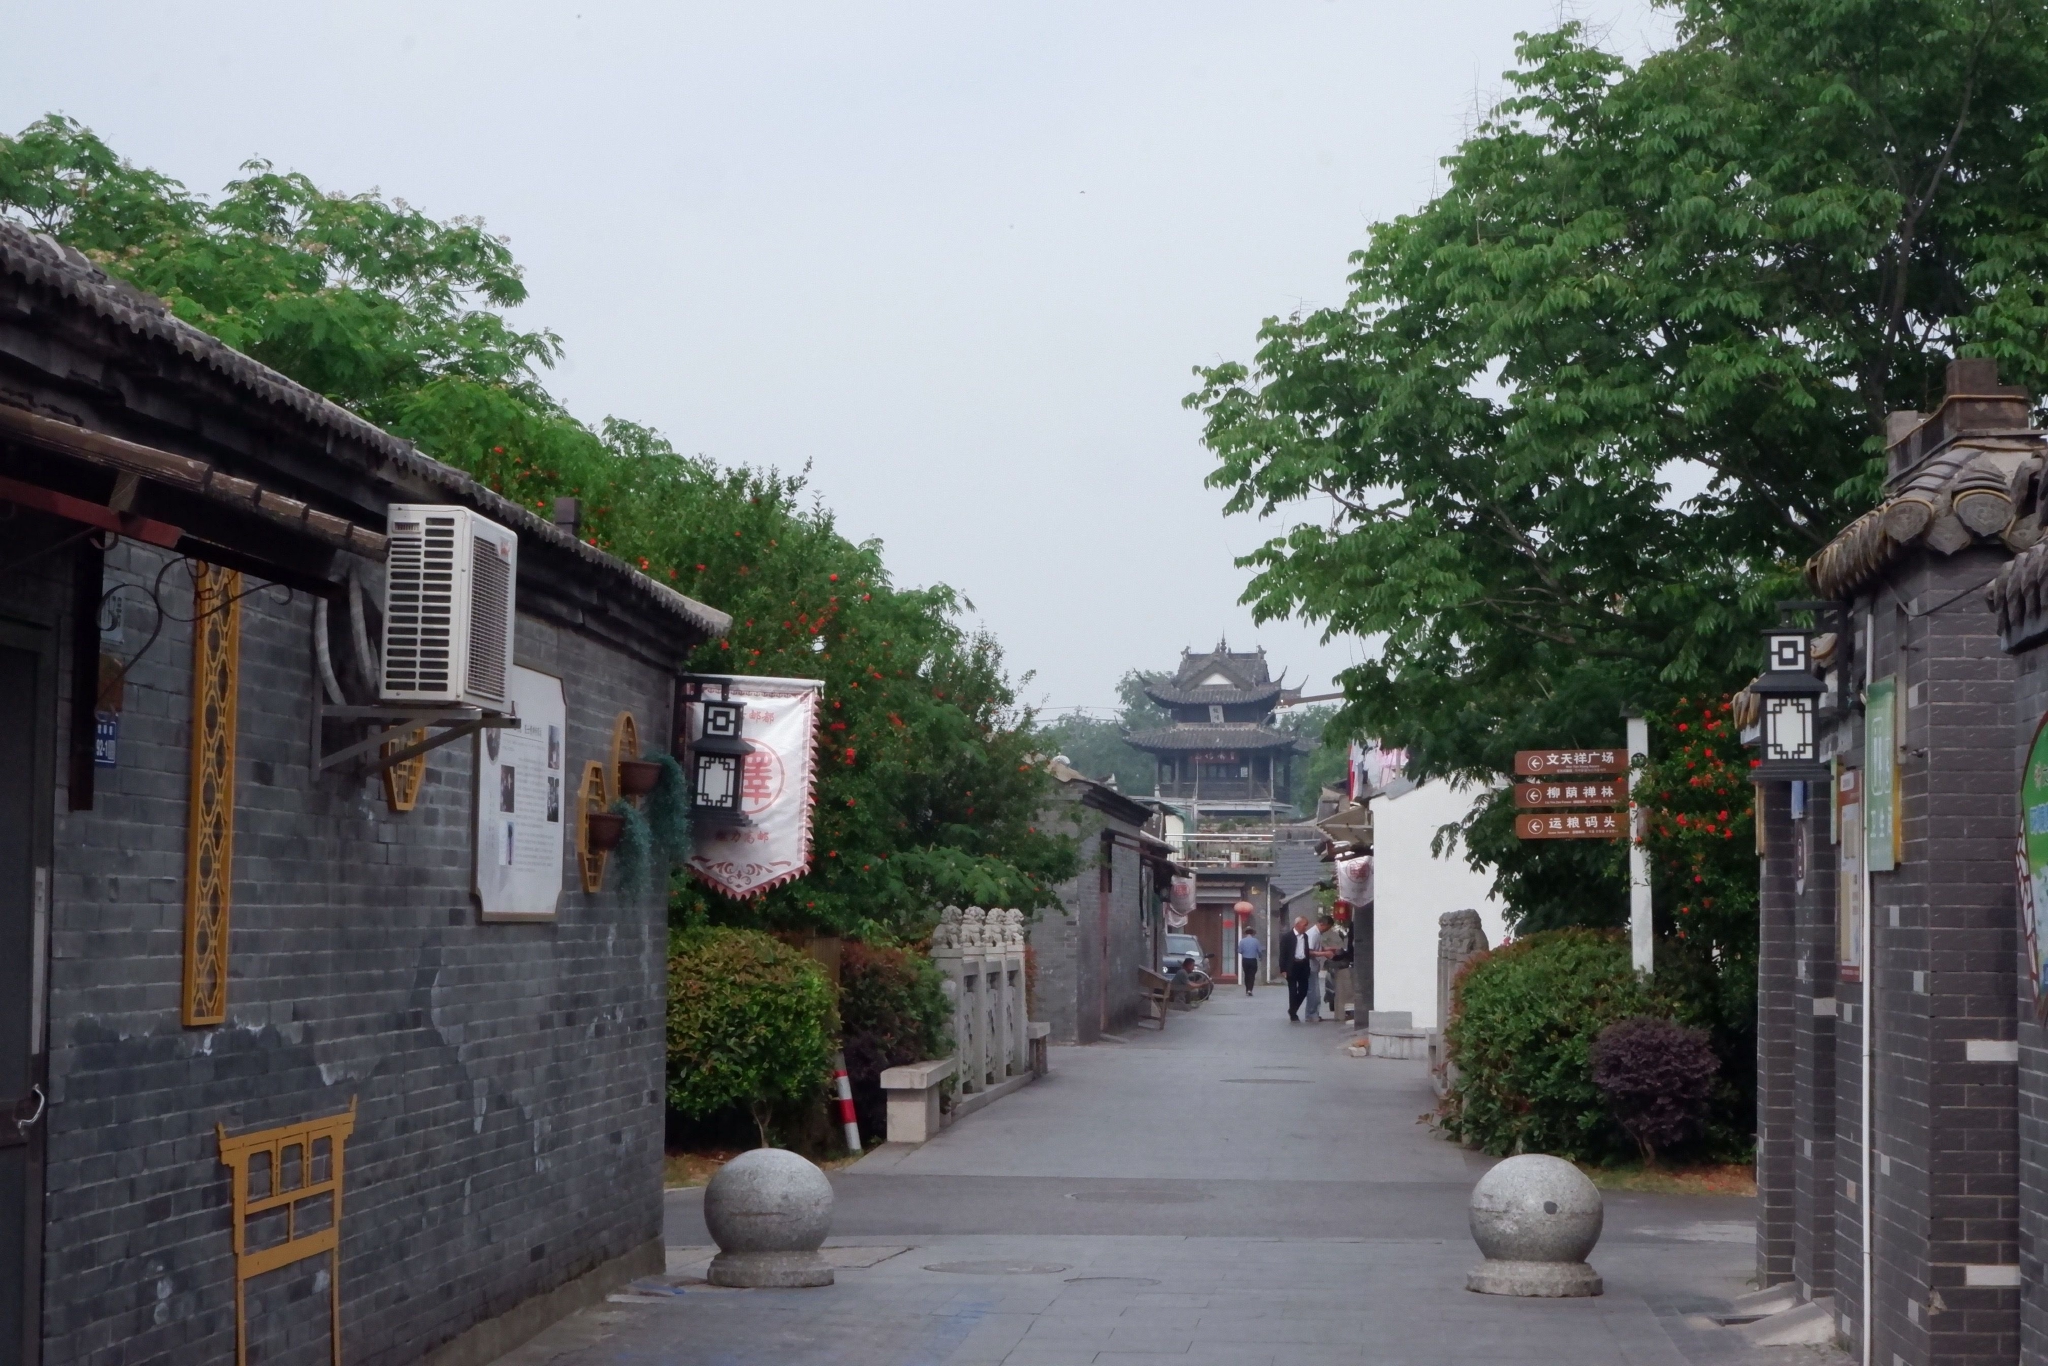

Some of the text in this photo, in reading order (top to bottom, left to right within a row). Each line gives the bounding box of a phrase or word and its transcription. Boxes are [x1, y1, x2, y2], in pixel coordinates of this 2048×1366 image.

[741, 710, 774, 724] 邮都
[1546, 752, 1614, 765] 文天祥广场
[1546, 786, 1614, 799] 柳荫禅林
[1548, 816, 1616, 829] 运粮码头
